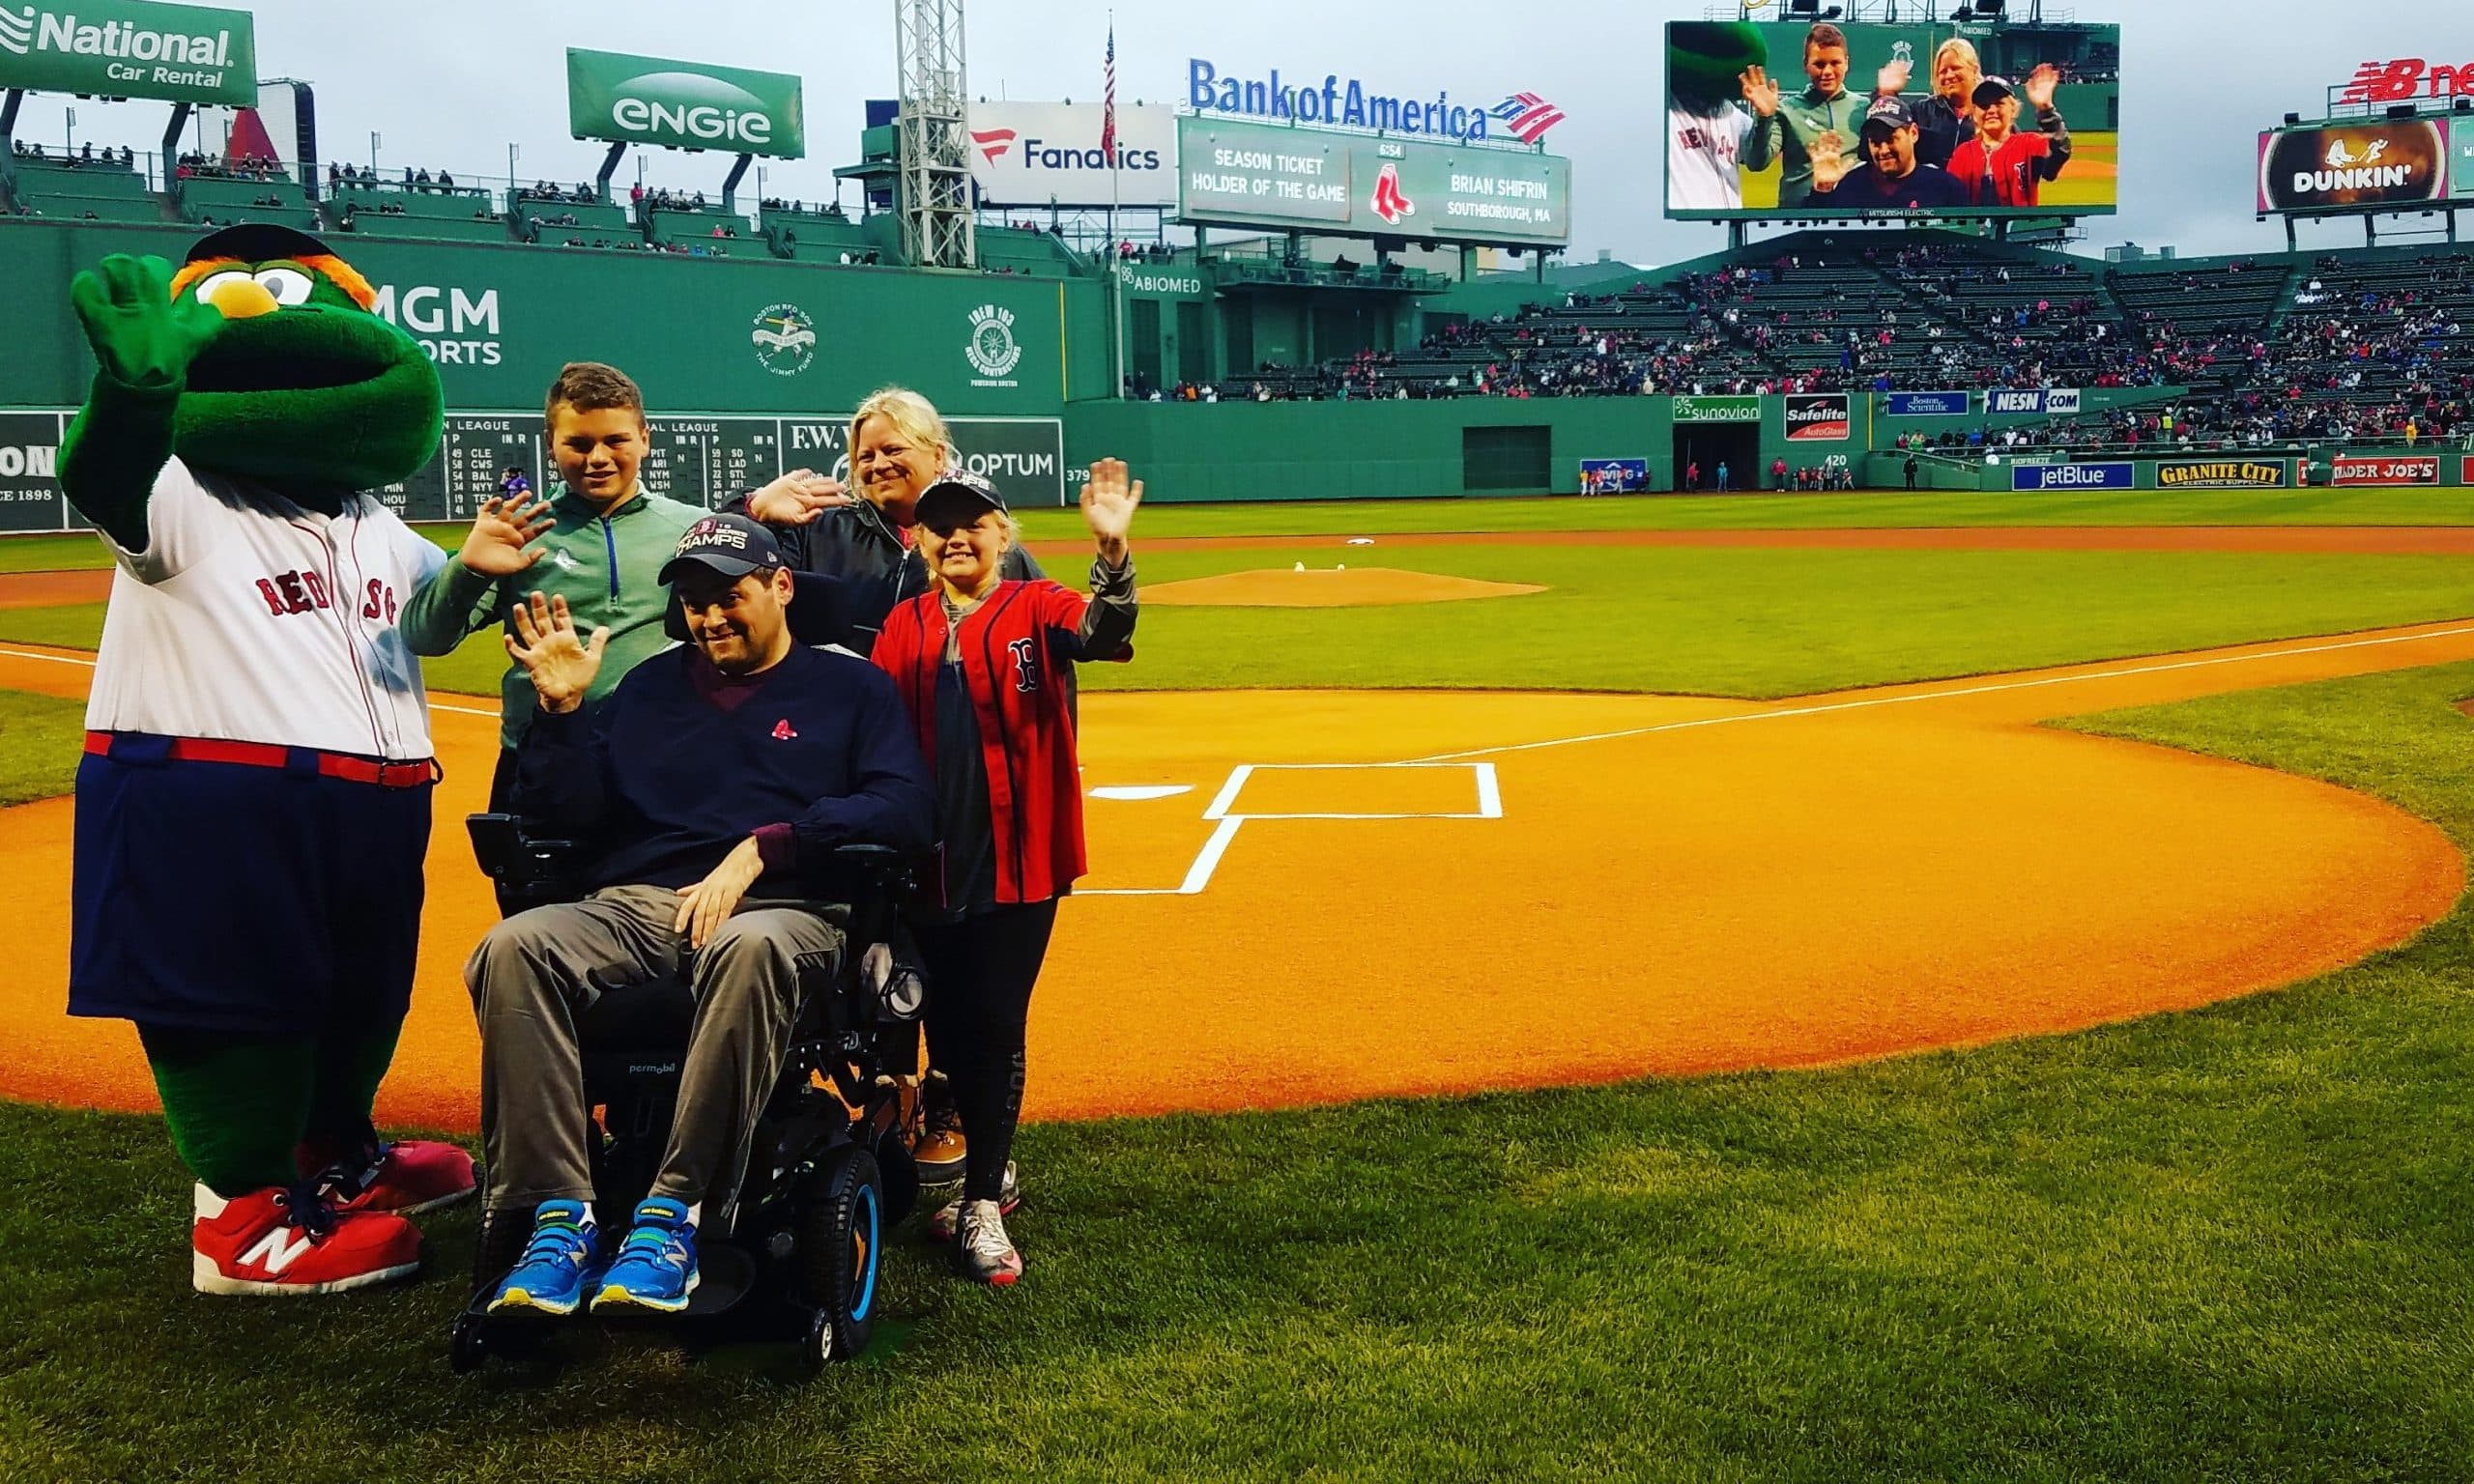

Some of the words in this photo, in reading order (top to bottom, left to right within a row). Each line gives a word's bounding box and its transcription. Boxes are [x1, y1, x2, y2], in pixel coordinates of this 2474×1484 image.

[37, 13, 230, 68] National
[106, 63, 146, 81] Car
[153, 67, 223, 88] Rental
[1189, 58, 1292, 118] Bank
[1298, 75, 1338, 124] of
[1343, 79, 1487, 141] America
[1024, 139, 1160, 170] Fanaics
[1379, 144, 1401, 157] 6:54
[1215, 148, 1272, 171] SEASON
[1276, 155, 1324, 176] TICKET
[1193, 172, 1248, 194] HOLDER
[1252, 179, 1271, 197] OF
[1276, 180, 1304, 200] THE
[1307, 184, 1346, 203] GAME
[1452, 175, 1493, 196] BRIAN
[1498, 179, 1547, 200] SHIFRIN
[1448, 201, 1532, 223] SOUTHBOROUGH,
[1535, 208, 1551, 223] MA
[1134, 276, 1200, 293] ABIOMED
[417, 339, 502, 365] ORTS
[1913, 395, 1940, 405] Boston
[1691, 406, 1759, 419] sunovion
[1907, 402, 1948, 412] Scientific
[1788, 408, 1847, 421] Safelite
[457, 420, 510, 431] LEAGUE
[671, 423, 719, 433] LEAGUE
[1803, 427, 1847, 436] AutoGlass
[451, 434, 460, 443] P
[502, 434, 513, 444] IN
[518, 434, 527, 444] R
[690, 435, 698, 445] R
[712, 435, 720, 444] P
[767, 435, 774, 445] R
[471, 448, 492, 459] CLE
[650, 448, 667, 458] PIT
[731, 448, 743, 458] SD
[471, 460, 493, 470] CWS
[651, 459, 667, 469] ARI
[729, 459, 747, 469] LAD
[967, 454, 1053, 476] OPTUM
[1825, 454, 1847, 467] 420
[451, 471, 463, 481] 54
[472, 471, 493, 481] BAL
[547, 471, 559, 480] 50
[648, 470, 670, 480] NYM
[729, 470, 746, 479] STL
[1066, 470, 1091, 482] 379
[2161, 463, 2237, 484] GRANITE
[2241, 463, 2281, 483] CITY
[2383, 463, 2434, 478] JOE'S
[2040, 466, 2105, 488] jetBlue
[384, 483, 404, 493] MIN
[472, 482, 493, 492] NYY
[648, 480, 671, 490] WSH
[17, 490, 53, 501] 1898
[383, 495, 407, 504] HOU
[454, 493, 464, 503] 19
[390, 506, 406, 516] ET
[676, 533, 746, 555] CHAMPS
[255, 570, 330, 616] RED
[629, 1063, 676, 1074] permobil
